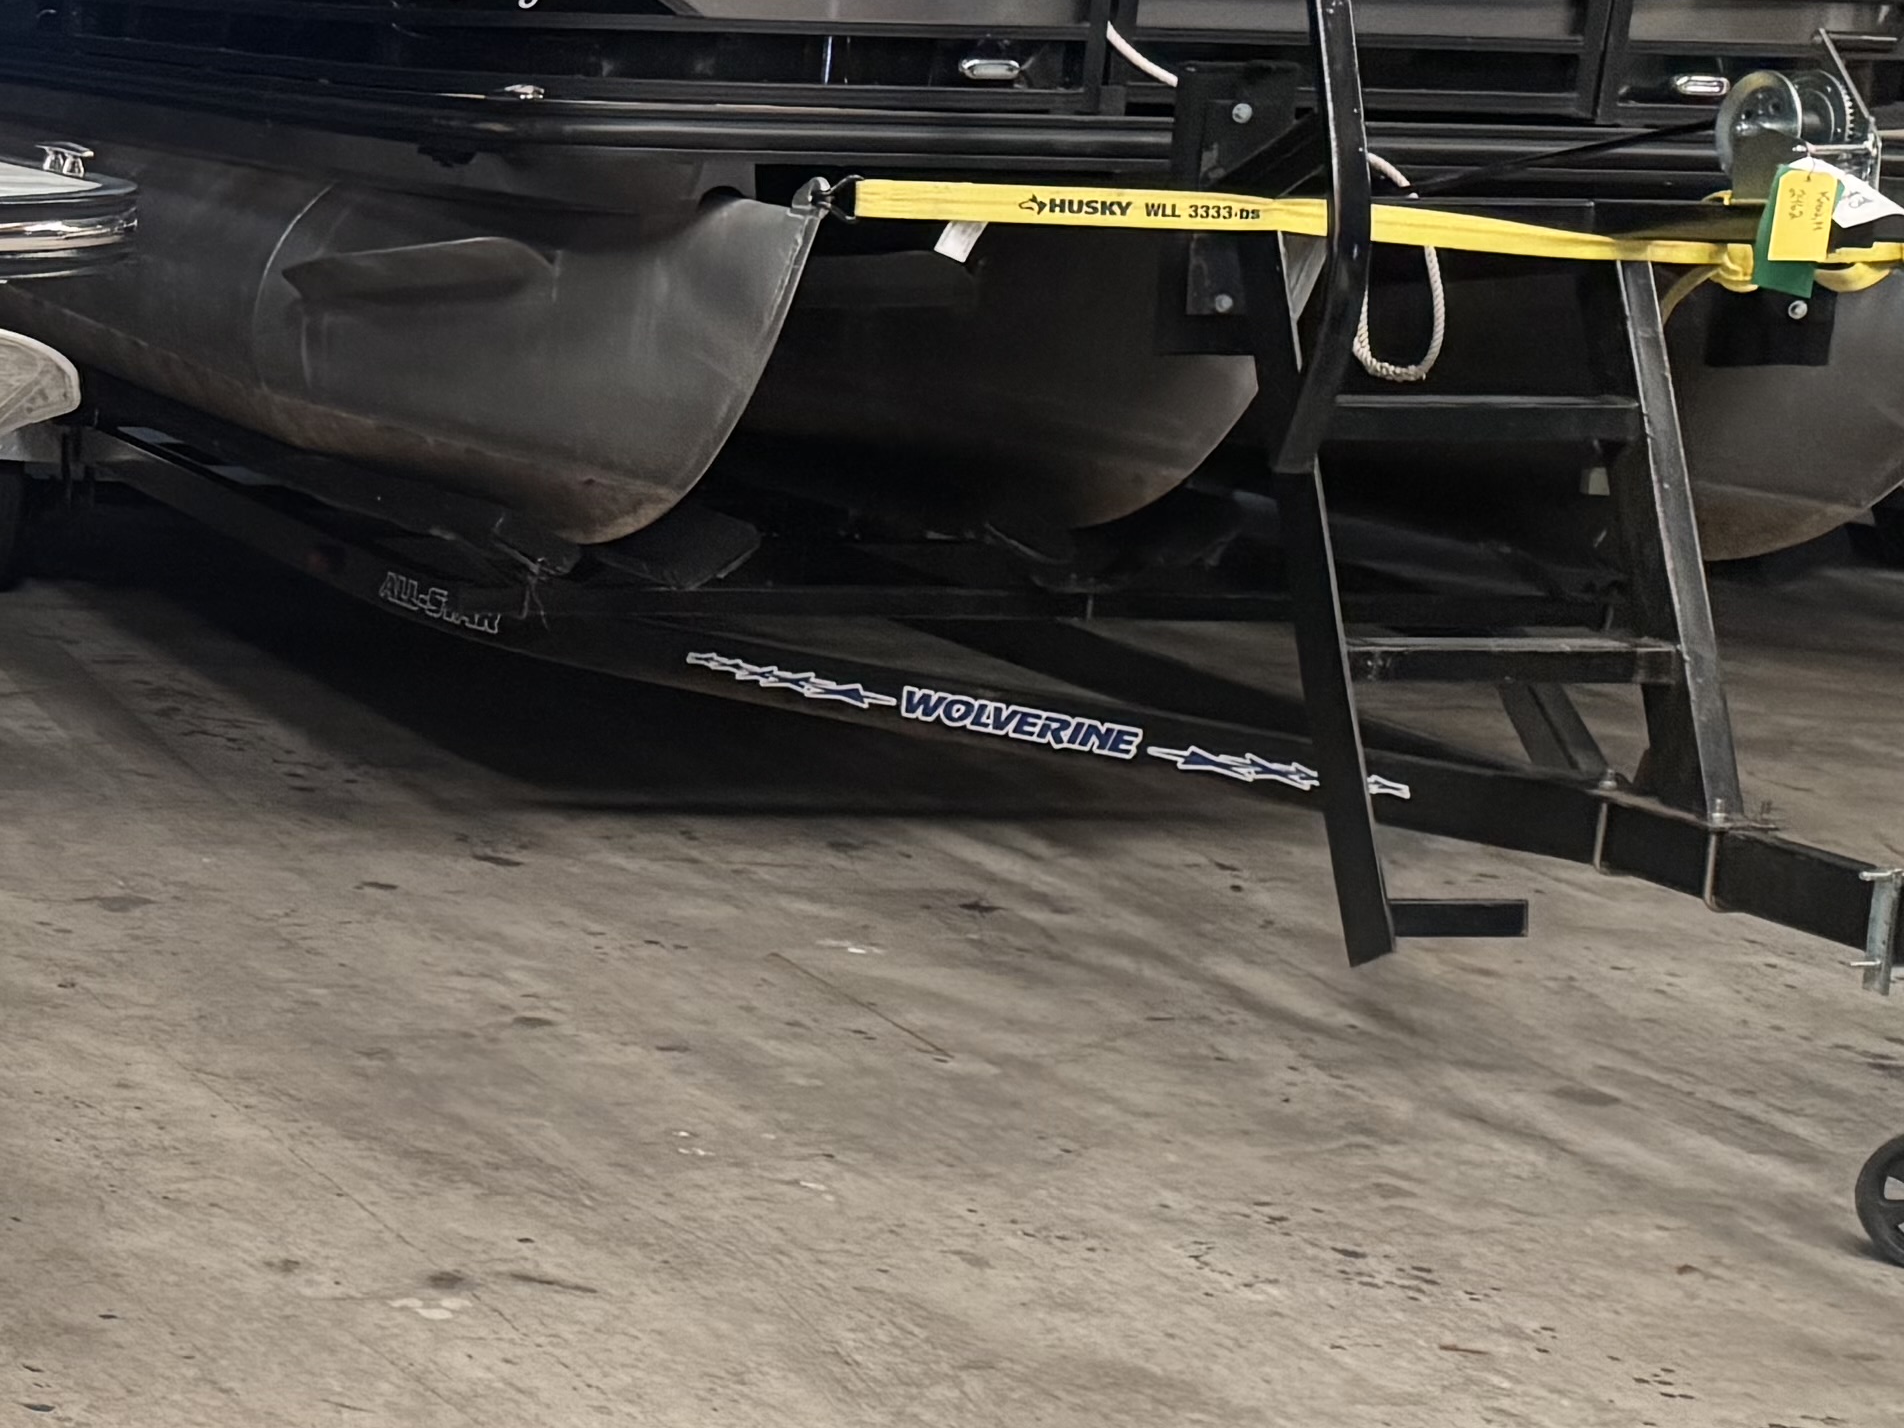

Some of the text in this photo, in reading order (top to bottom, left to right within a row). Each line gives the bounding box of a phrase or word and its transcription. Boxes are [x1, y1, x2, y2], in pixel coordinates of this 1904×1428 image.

[1049, 198, 1133, 217] HUSKY
[1145, 202, 1181, 218] WLL
[901, 685, 1144, 760] WOLVERINE
